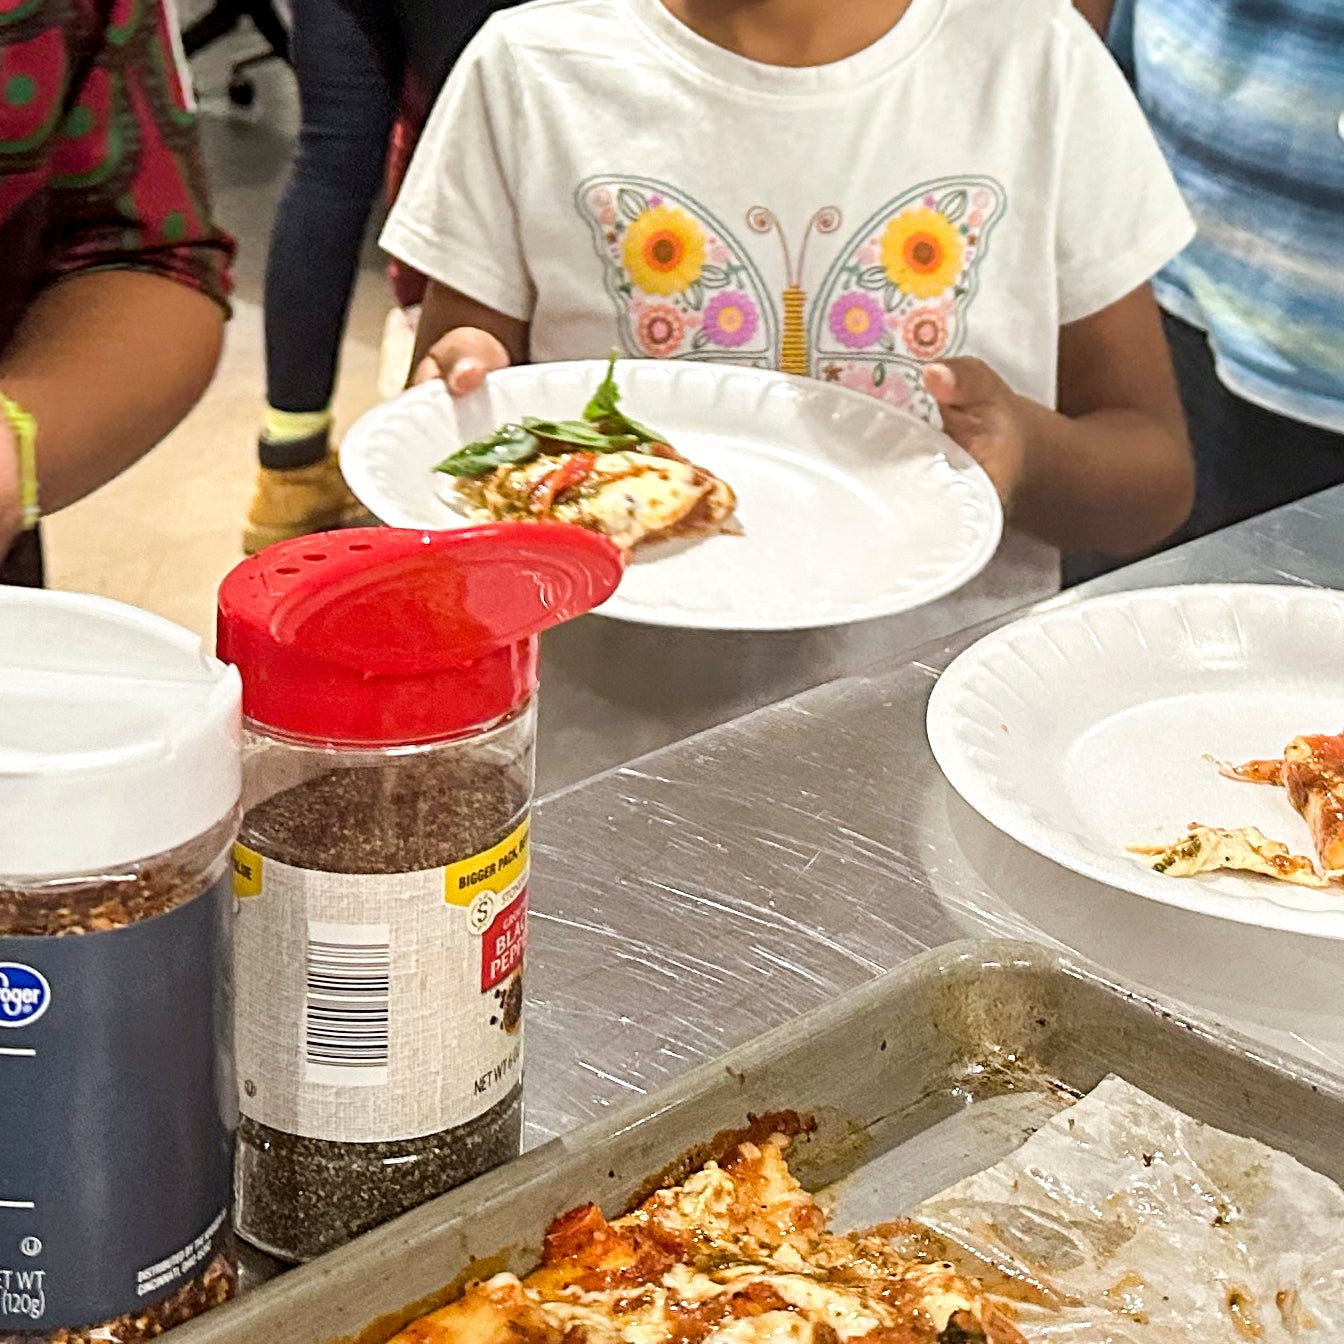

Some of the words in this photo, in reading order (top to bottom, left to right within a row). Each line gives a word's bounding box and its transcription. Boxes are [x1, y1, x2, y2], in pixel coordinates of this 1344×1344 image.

[459, 863, 496, 890] BIGGER
[474, 1070, 493, 1096] NET
[16, 1270, 46, 1290] WT
[2, 1288, 46, 1319] (120g)
